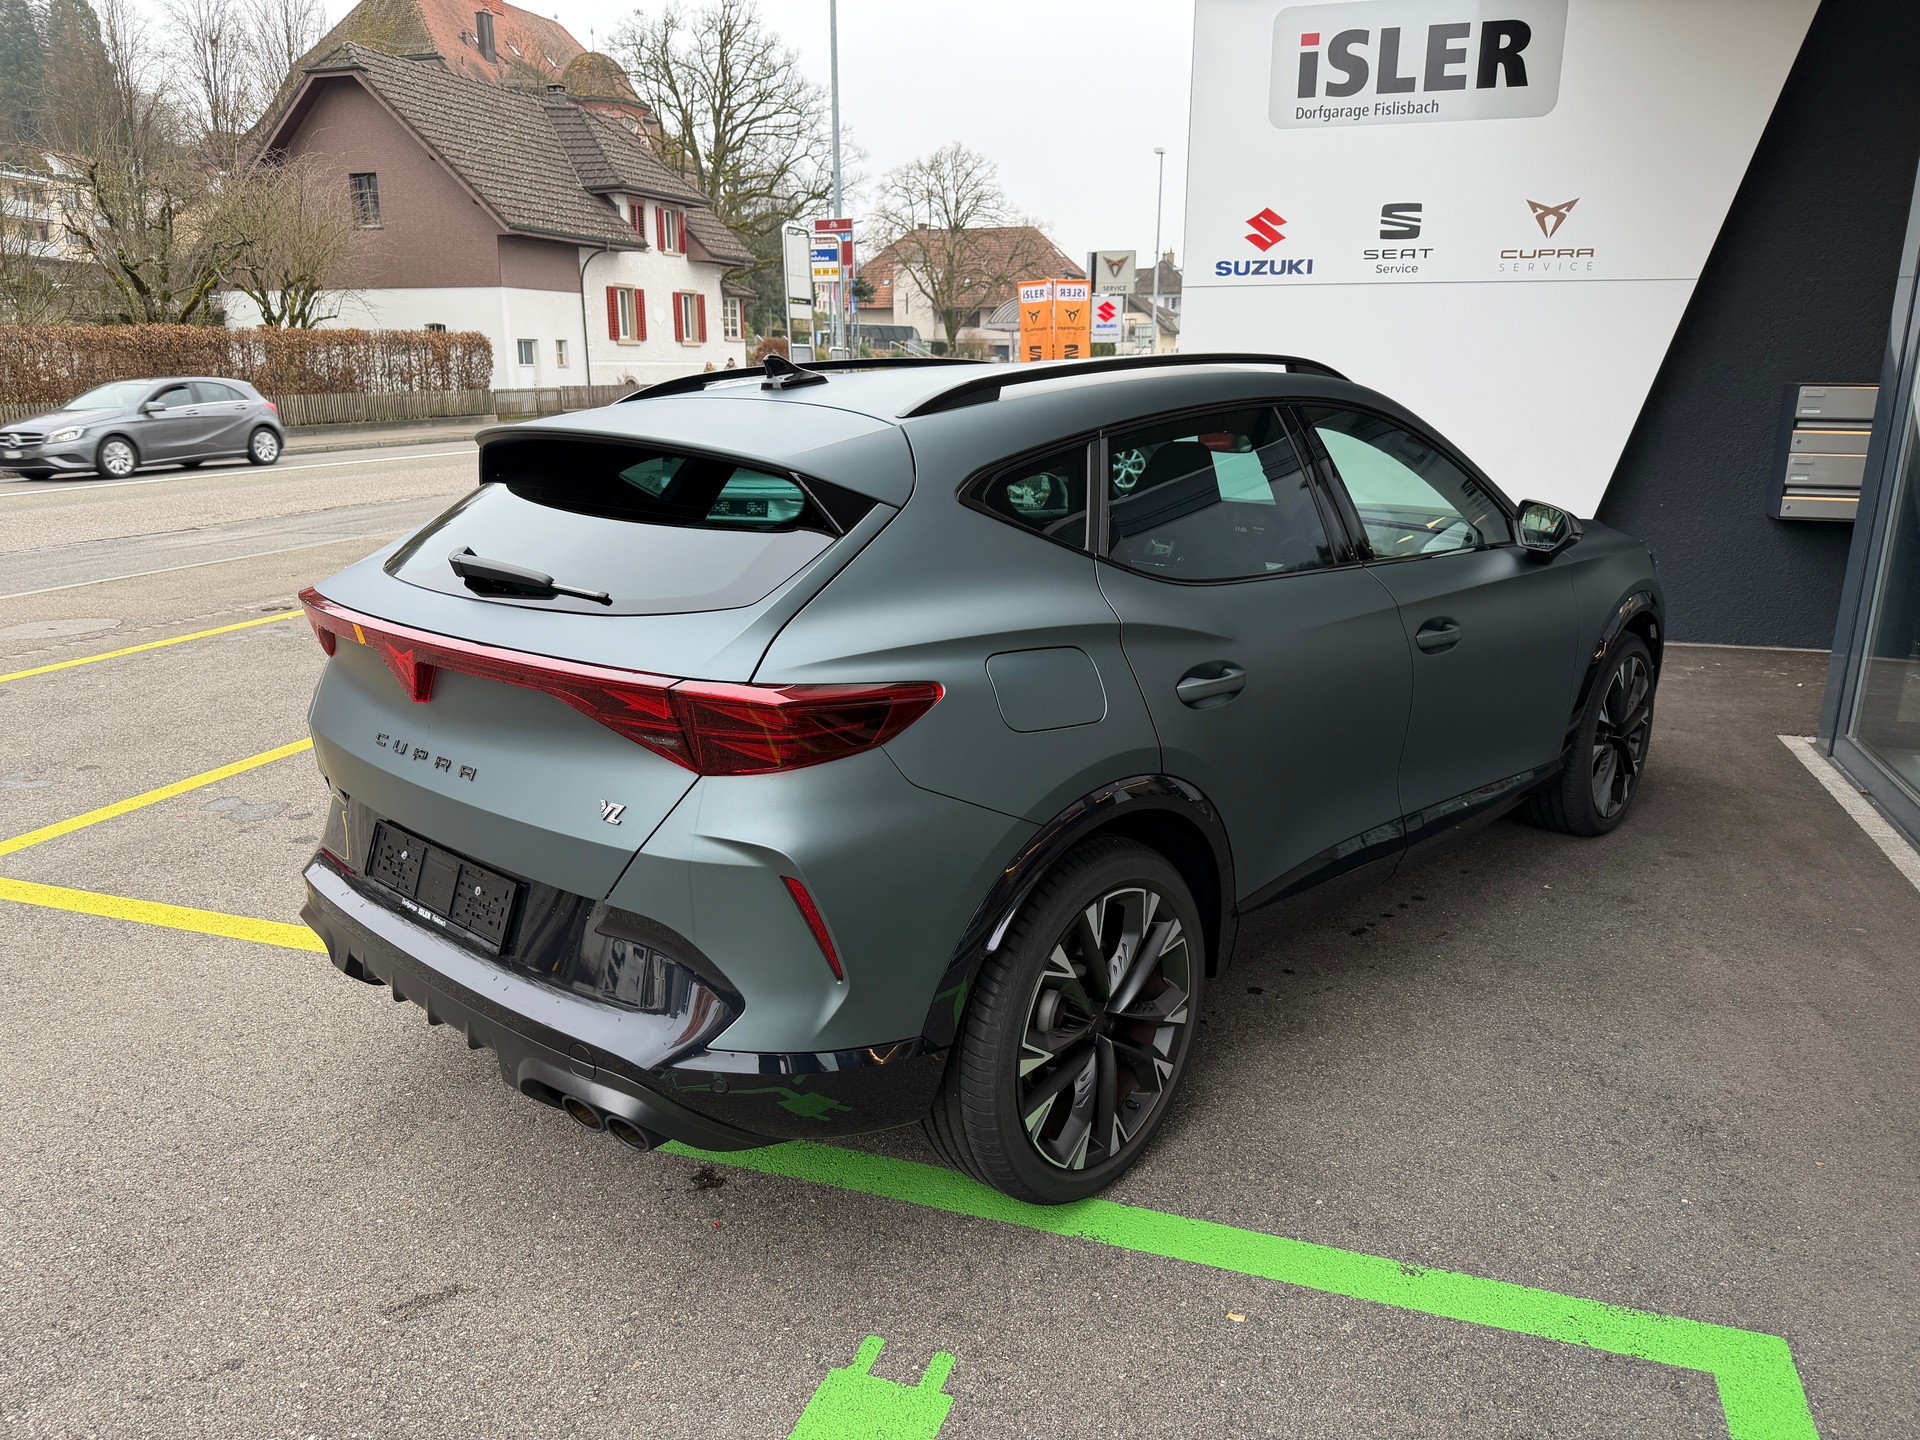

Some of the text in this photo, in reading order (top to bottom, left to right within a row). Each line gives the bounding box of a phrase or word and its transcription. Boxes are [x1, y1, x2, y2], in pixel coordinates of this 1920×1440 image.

[1297, 18, 1532, 98] iSLER
[1295, 99, 1439, 122] Dorfgarage Fislisbach
[1363, 247, 1434, 260] SEAT
[1500, 247, 1595, 260] CUPRA
[1215, 258, 1314, 277] SUZUKI
[1375, 263, 1419, 275] Service
[1499, 261, 1594, 273] SERVICE
[375, 731, 478, 782] CUPRA
